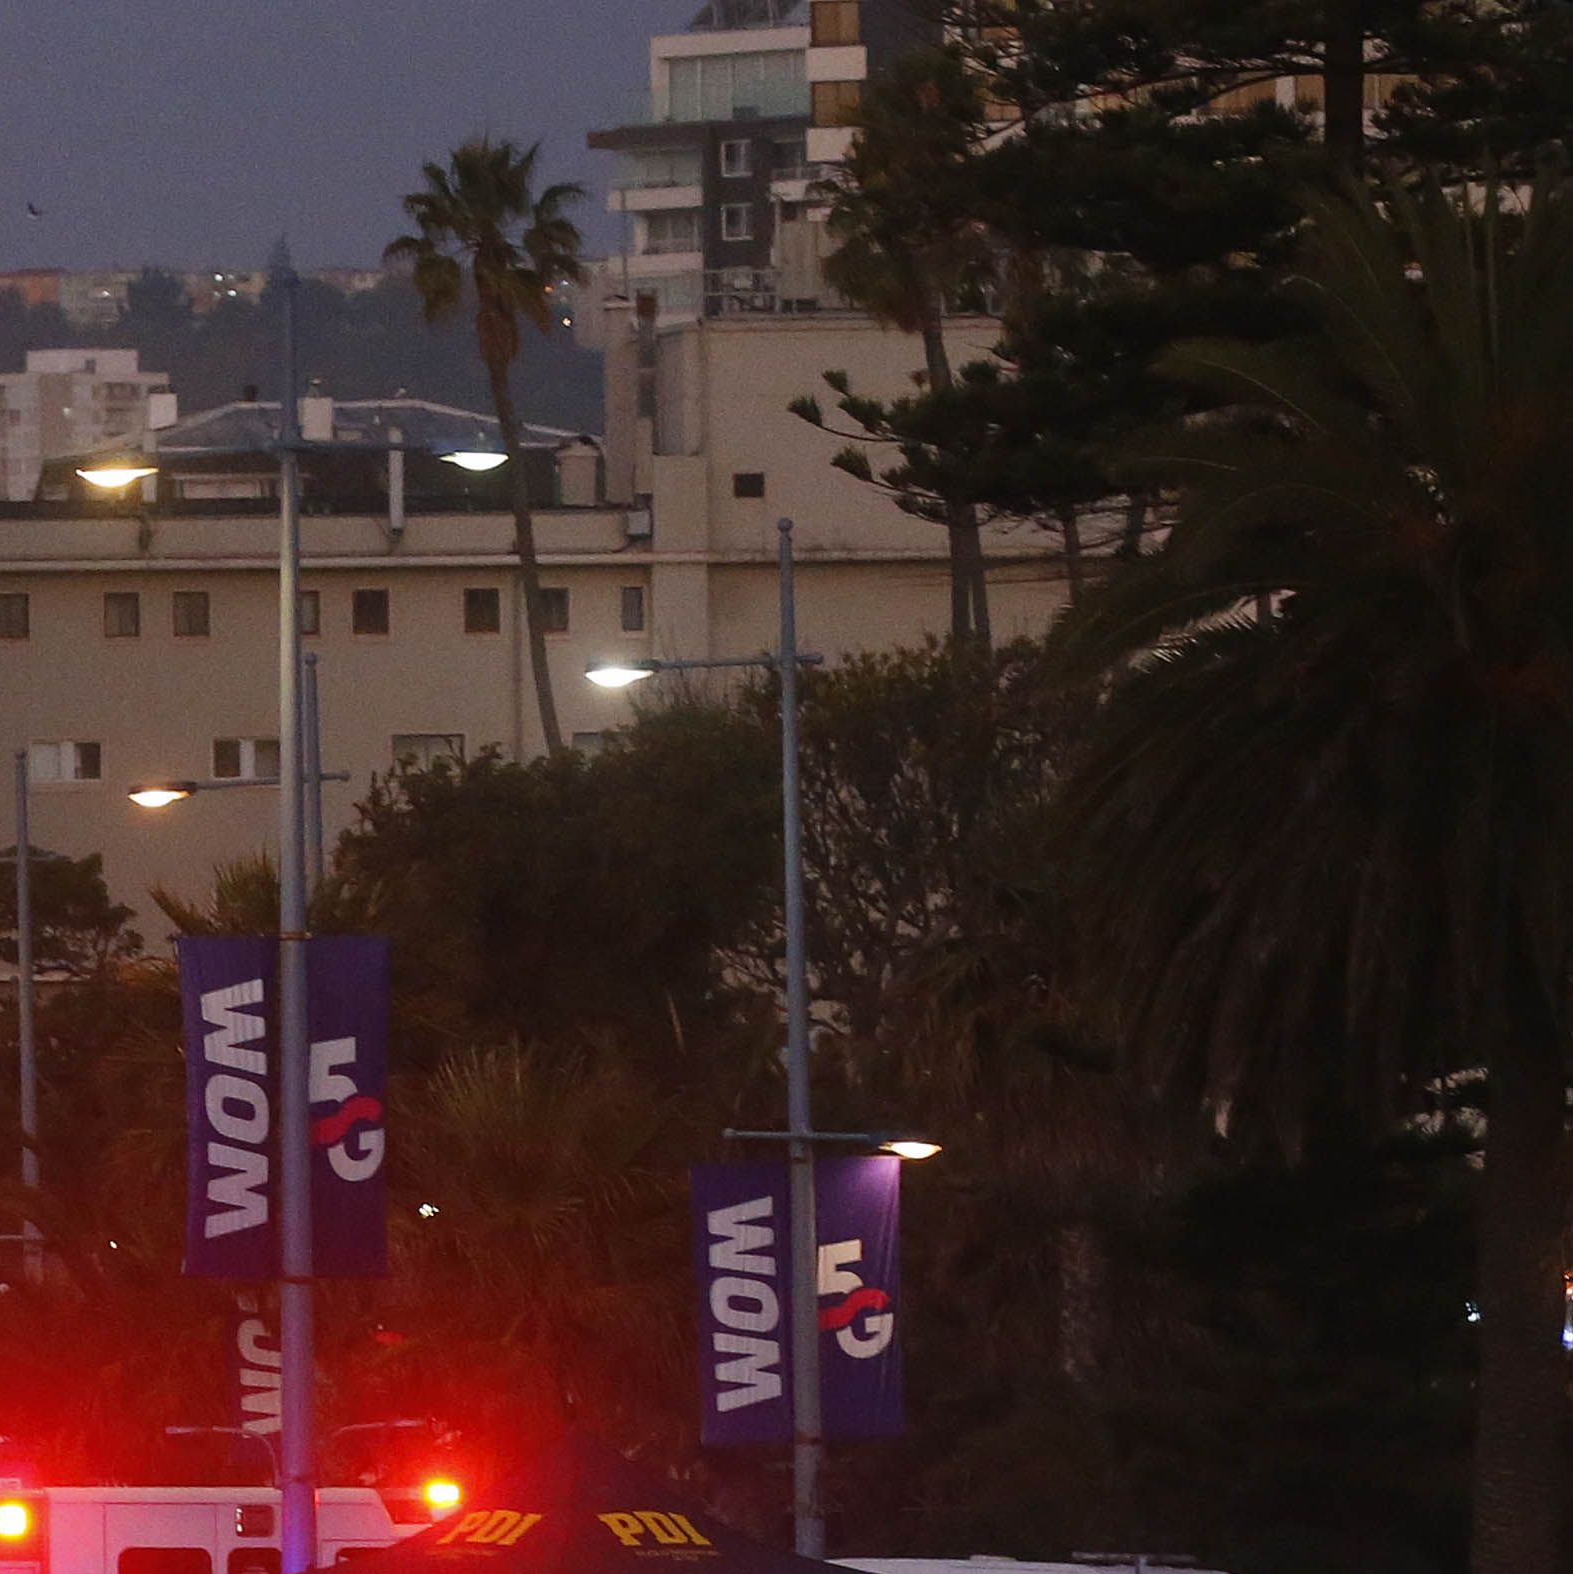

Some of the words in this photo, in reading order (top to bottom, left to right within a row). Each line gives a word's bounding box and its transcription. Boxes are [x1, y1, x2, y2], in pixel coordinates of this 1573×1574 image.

[200, 978, 269, 1239] WOM
[310, 1037, 385, 1182] 5G
[706, 1196, 783, 1413] WOM
[818, 1240, 894, 1359] 5G
[437, 1510, 542, 1546] PDI
[598, 1510, 711, 1546] PDI
